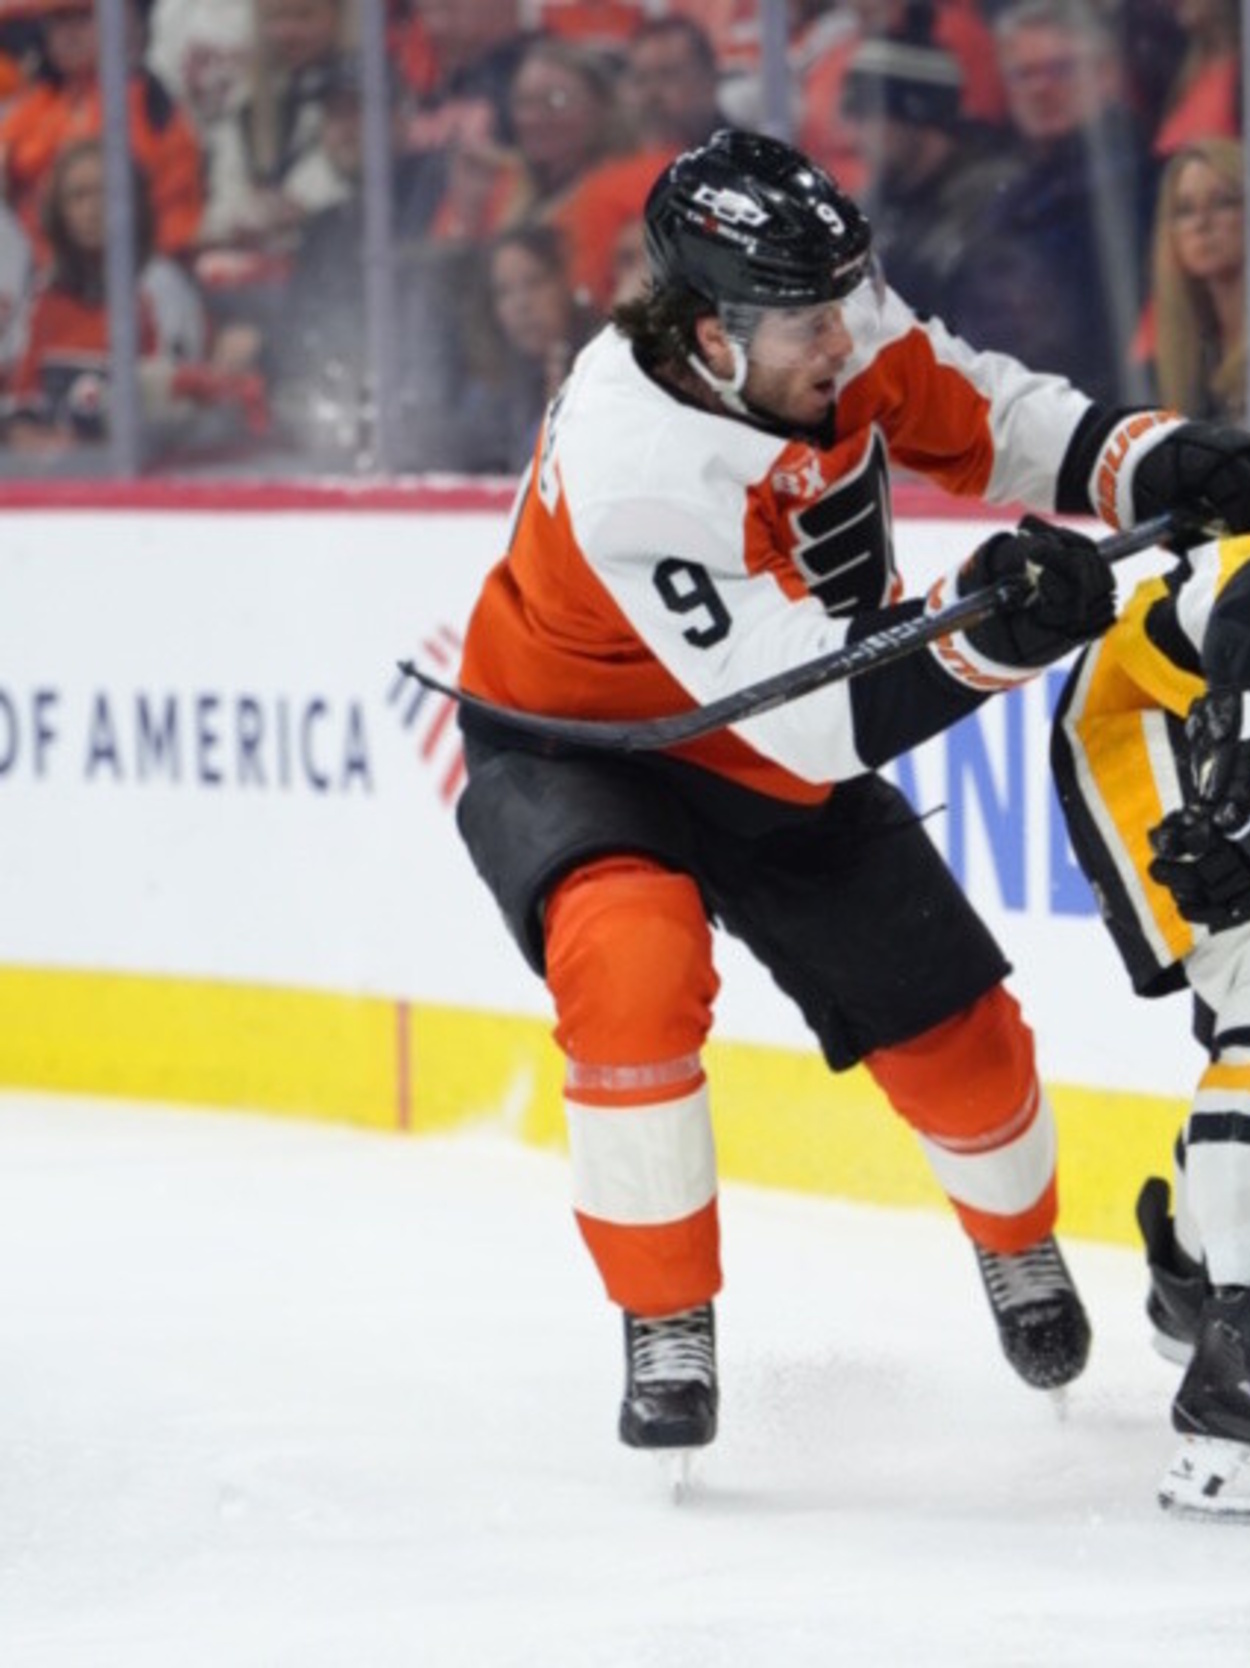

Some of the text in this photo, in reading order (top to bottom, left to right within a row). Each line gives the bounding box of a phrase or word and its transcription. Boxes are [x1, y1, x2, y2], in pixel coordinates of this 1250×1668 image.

[816, 202, 845, 236] 9
[653, 556, 733, 649] 9
[84, 689, 374, 792] AMERICA
